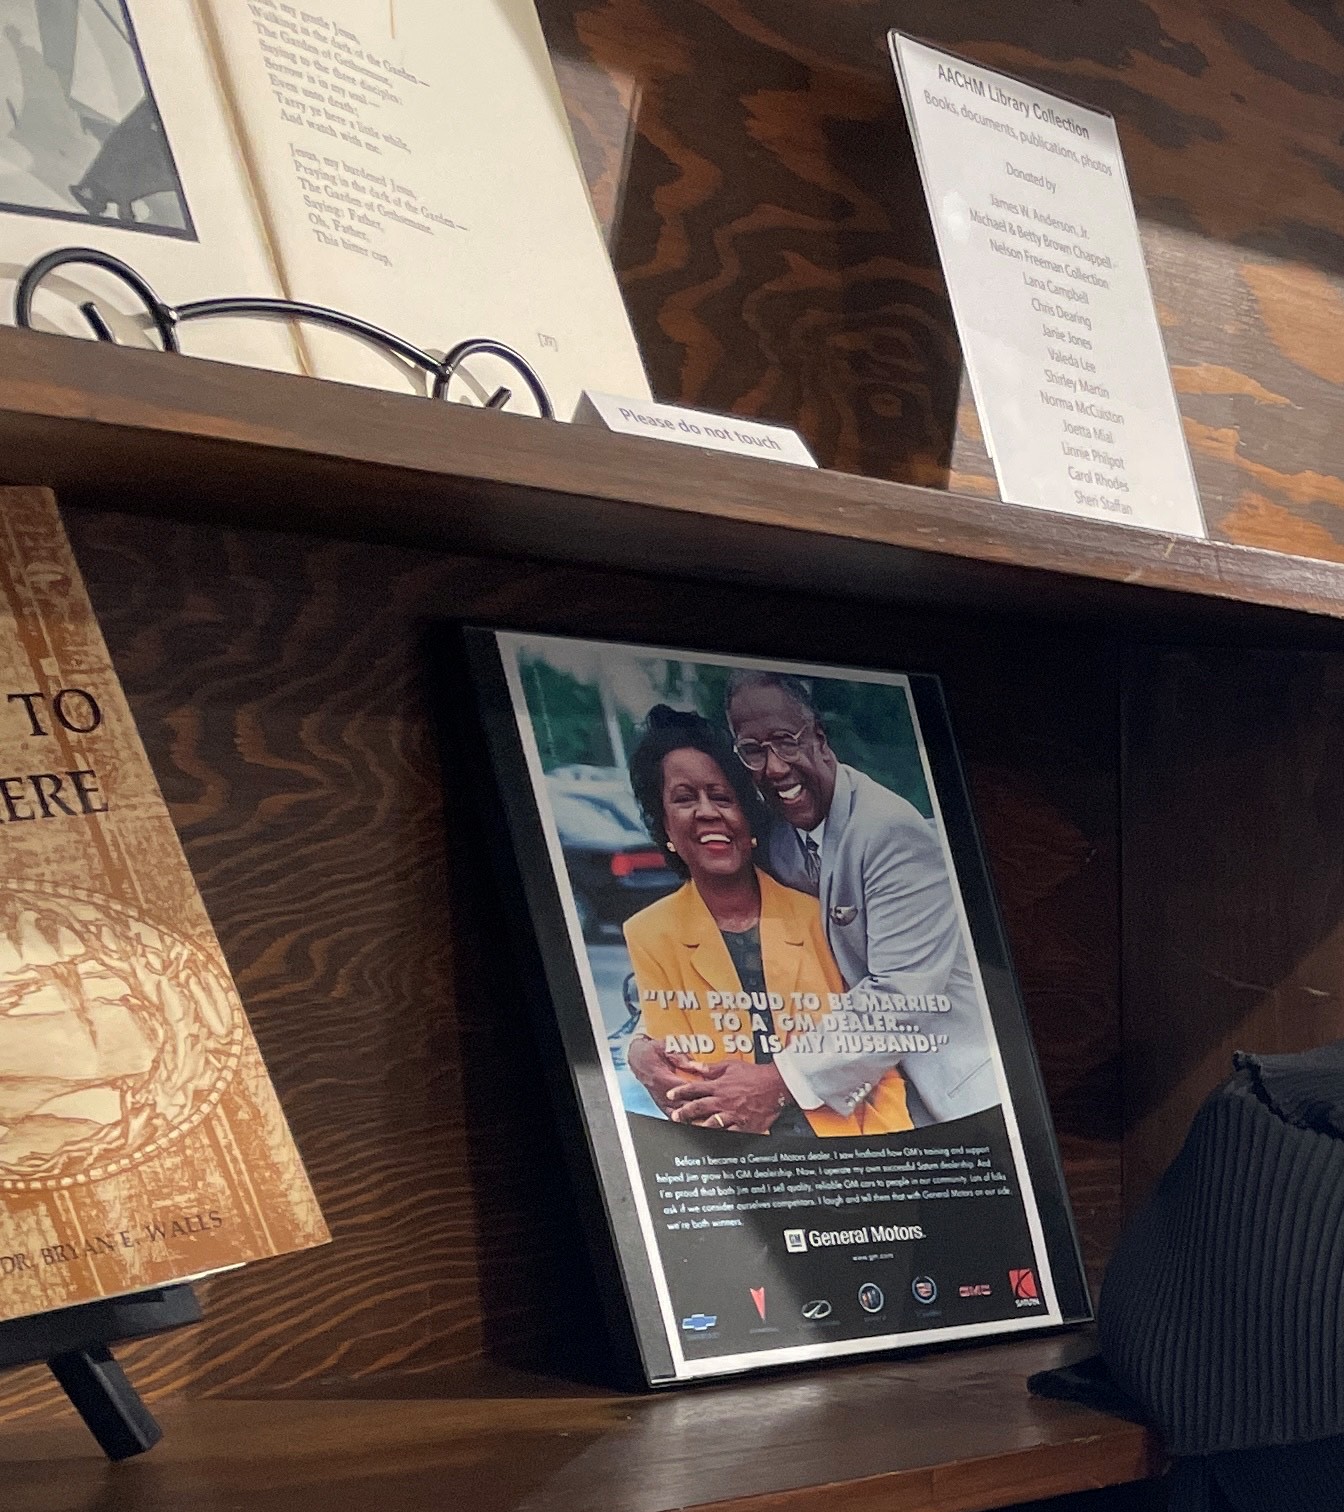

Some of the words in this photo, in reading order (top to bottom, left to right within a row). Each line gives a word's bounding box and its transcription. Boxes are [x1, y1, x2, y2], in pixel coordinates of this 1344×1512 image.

[938, 64, 985, 97] AACHM
[988, 84, 1029, 118] Library
[1033, 103, 1089, 139] Collection
[924, 90, 959, 116] Books,
[961, 104, 1018, 140] documents,
[1020, 130, 1079, 163] publications,
[1081, 154, 1112, 176] photos
[1006, 162, 1043, 187] Donated
[1045, 178, 1056, 193] by
[990, 194, 1019, 214] James
[969, 208, 1007, 232] Michael
[1009, 220, 1016, 235] &
[1017, 225, 1041, 247] Betty
[1043, 234, 1072, 255] Brown
[990, 239, 1023, 261] Nelson
[1024, 250, 1064, 273] Freeman
[1065, 265, 1109, 289] Collection
[618, 407, 674, 430] Please
[678, 419, 700, 435] do
[705, 427, 734, 441] not
[735, 431, 782, 451] touch
[7, 688, 102, 737] TO
[0, 769, 109, 823] ERE
[707, 992, 785, 1011] PROUD
[791, 992, 821, 1011] TO
[828, 992, 853, 1012] BE
[859, 992, 952, 1014] MARRIED
[711, 1014, 742, 1032] TO
[751, 1014, 769, 1033] A
[782, 1014, 816, 1033] GM
[824, 1013, 921, 1034] DEALER...
[665, 1034, 715, 1054] AND
[723, 1034, 754, 1054] SO
[761, 1034, 783, 1054] IS
[790, 1034, 827, 1054] MY
[834, 1033, 949, 1054] HUSBAND!"
[41, 1236, 114, 1266] BRYAN
[119, 1230, 141, 1249] E.
[146, 1210, 223, 1242] WALLS
[808, 1227, 869, 1248] General
[958, 1284, 992, 1298] GMC
